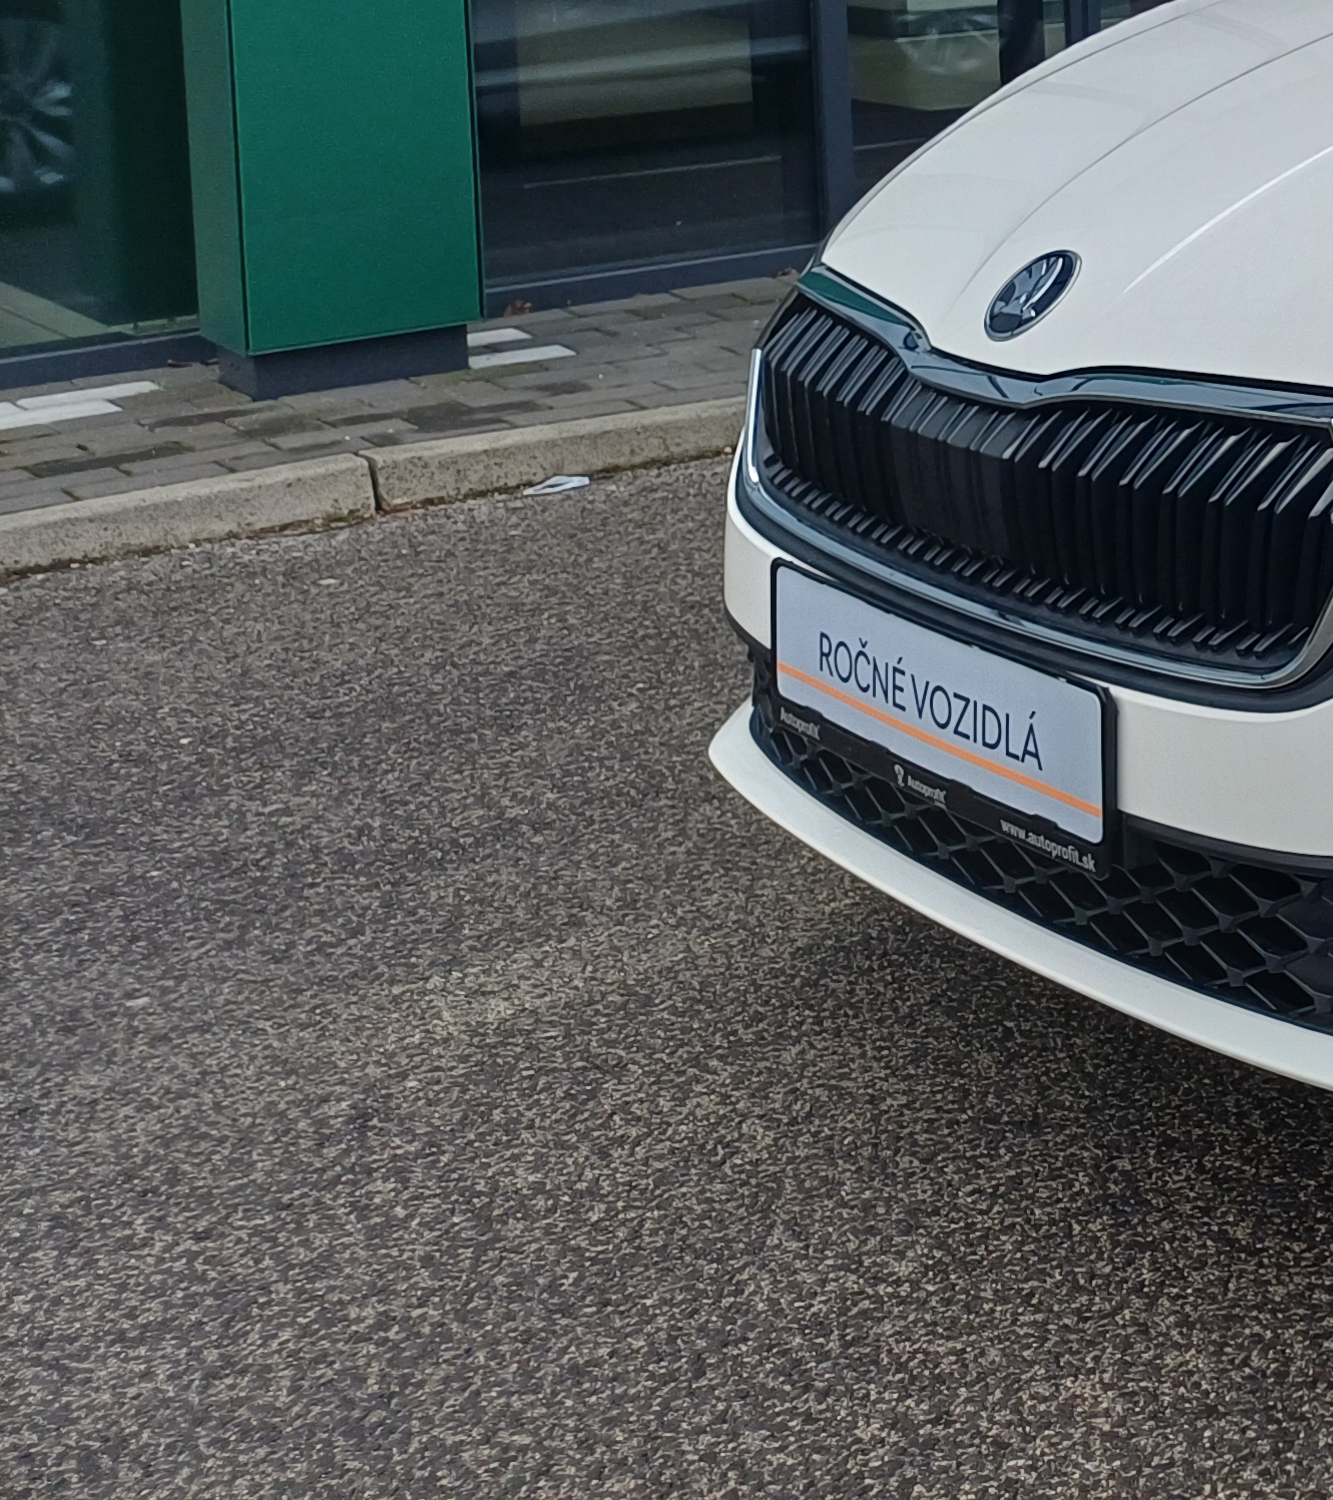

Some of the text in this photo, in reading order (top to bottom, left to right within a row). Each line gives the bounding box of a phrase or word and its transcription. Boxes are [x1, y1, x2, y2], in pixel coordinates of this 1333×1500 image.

[818, 631, 1044, 771] ROČNÉ VOZIDLÁ
[999, 819, 1097, 873] www.autoprofit.sk
